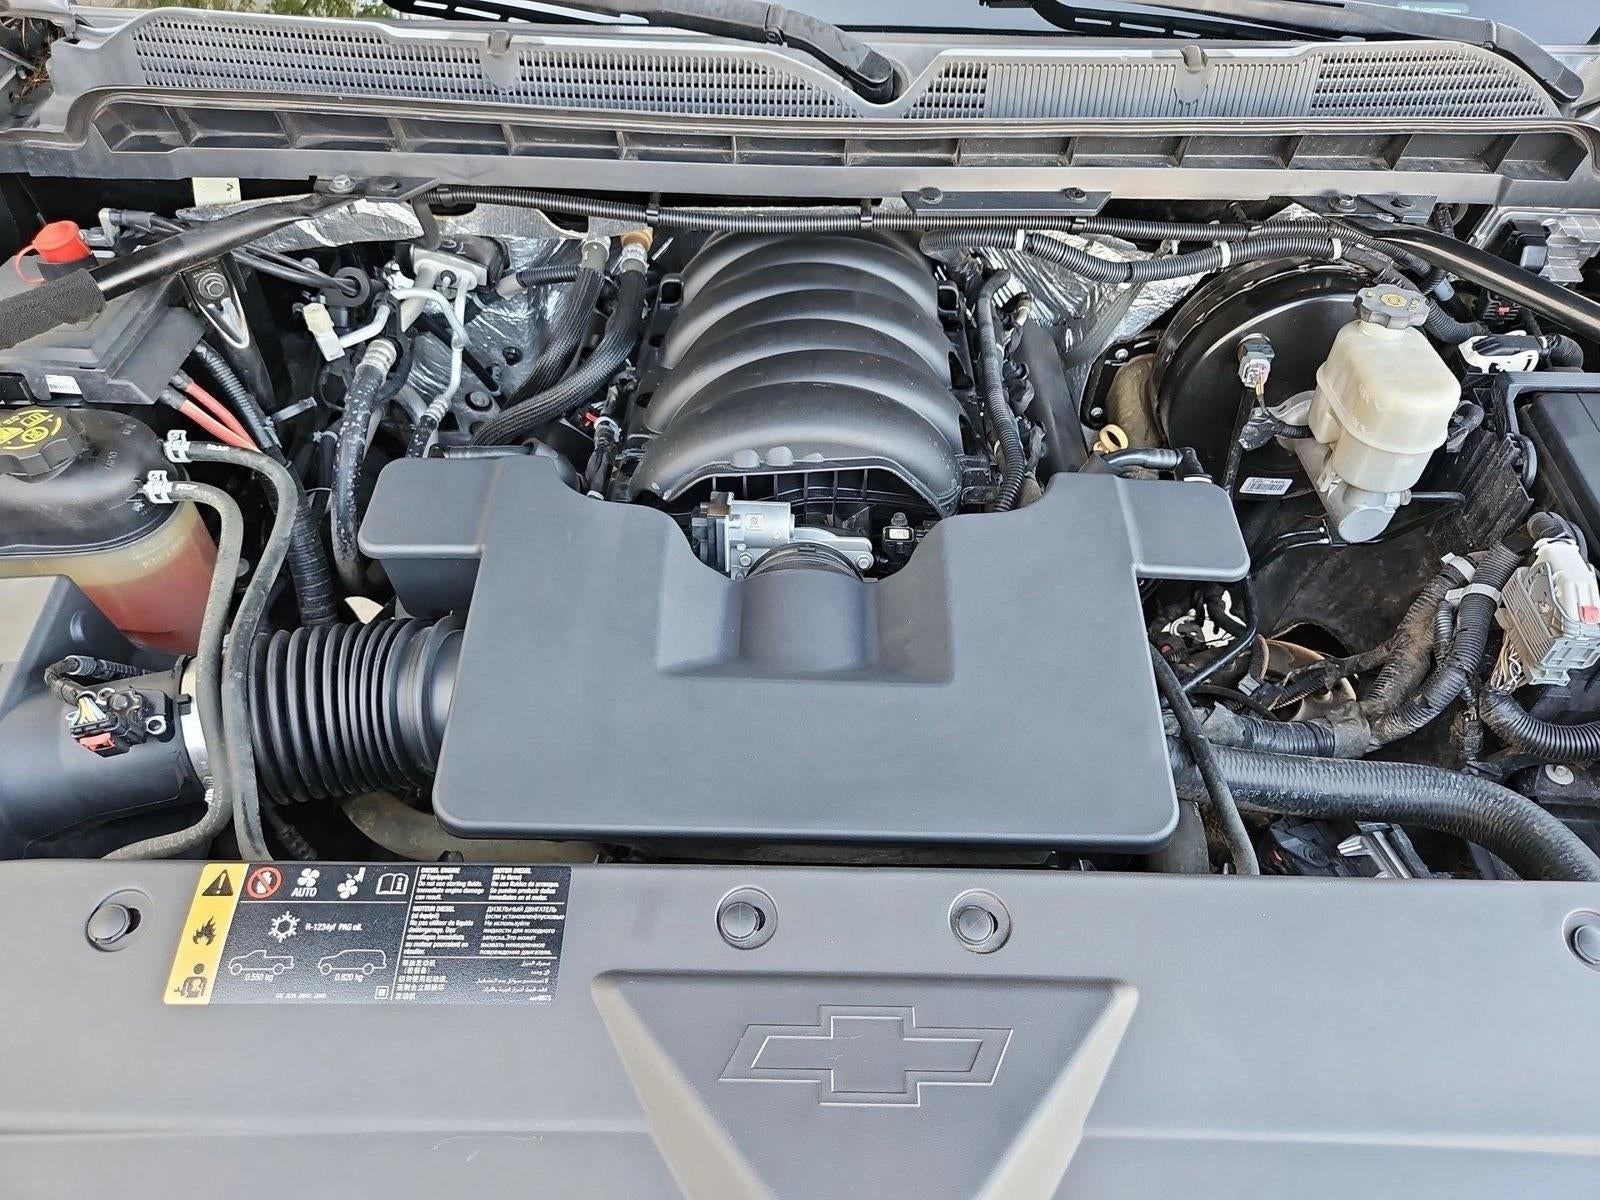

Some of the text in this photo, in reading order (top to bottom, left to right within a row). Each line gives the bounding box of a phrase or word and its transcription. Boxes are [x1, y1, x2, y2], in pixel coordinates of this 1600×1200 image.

[291, 887, 318, 897] AUTO
[305, 923, 336, 932] R-1234yf
[264, 974, 274, 982] kg
[354, 974, 364, 982] kg
